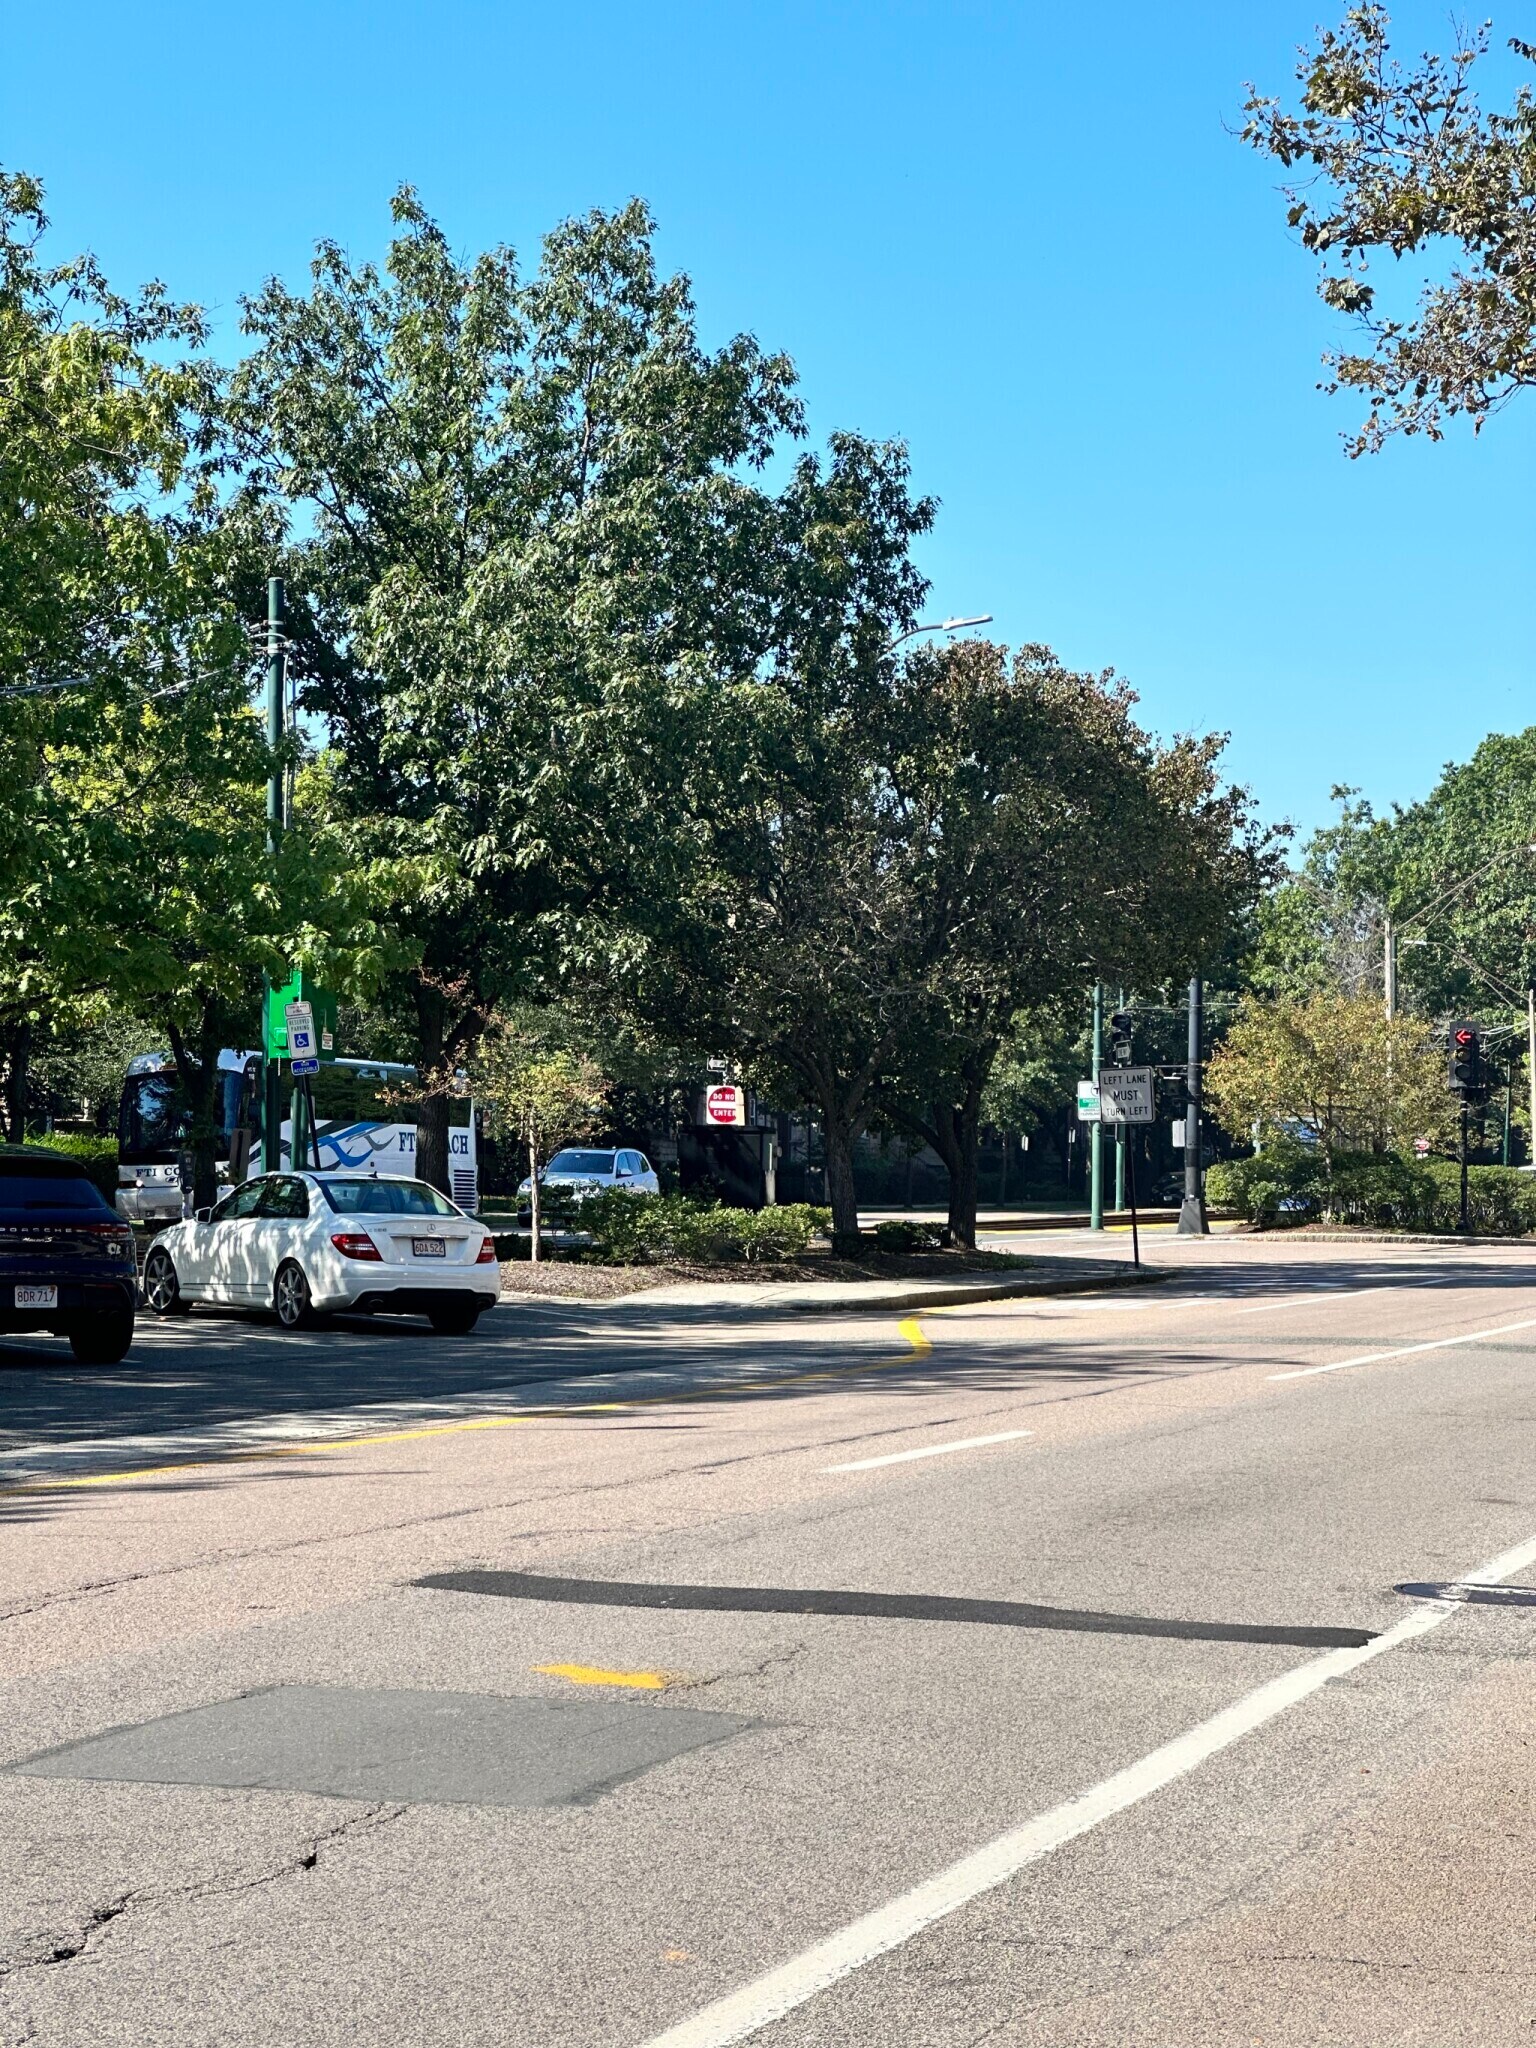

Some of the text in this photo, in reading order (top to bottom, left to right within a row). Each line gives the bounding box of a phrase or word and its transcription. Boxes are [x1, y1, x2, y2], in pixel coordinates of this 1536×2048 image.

[1103, 1074, 1147, 1085] LEFT LANE
[1113, 1090, 1138, 1101] MUST
[1106, 1107, 1126, 1117] TURN
[1129, 1106, 1148, 1116] LEFT
[135, 1168, 157, 1177] FTI
[17, 1290, 55, 1302] 8DR 717
